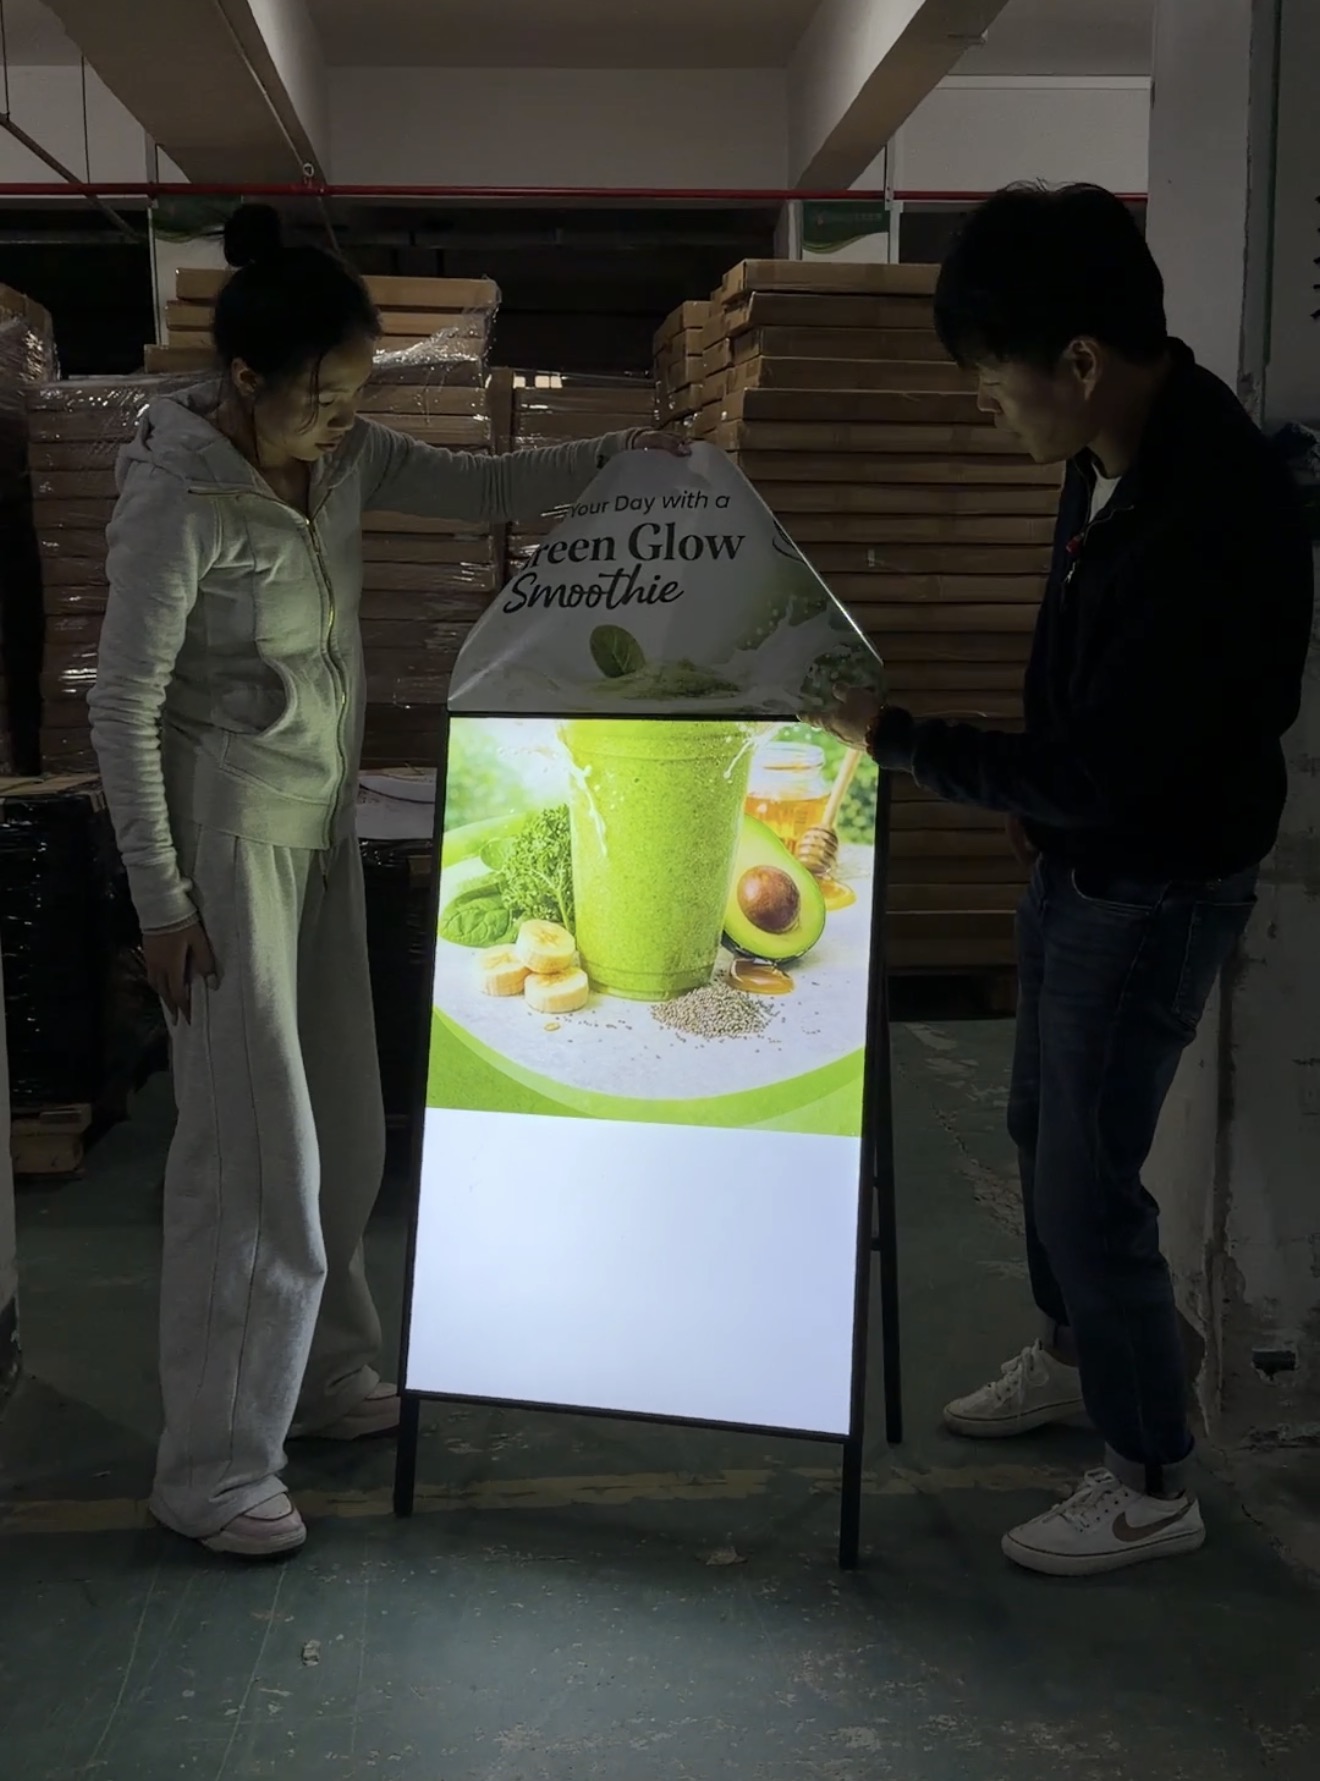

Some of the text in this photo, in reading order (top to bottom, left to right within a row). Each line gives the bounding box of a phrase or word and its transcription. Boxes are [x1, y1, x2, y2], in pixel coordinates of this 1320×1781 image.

[615, 496, 656, 515] Day
[662, 491, 708, 510] with
[716, 497, 731, 509] a
[521, 522, 746, 570] reen Glow
[503, 563, 685, 613] Smoothie
